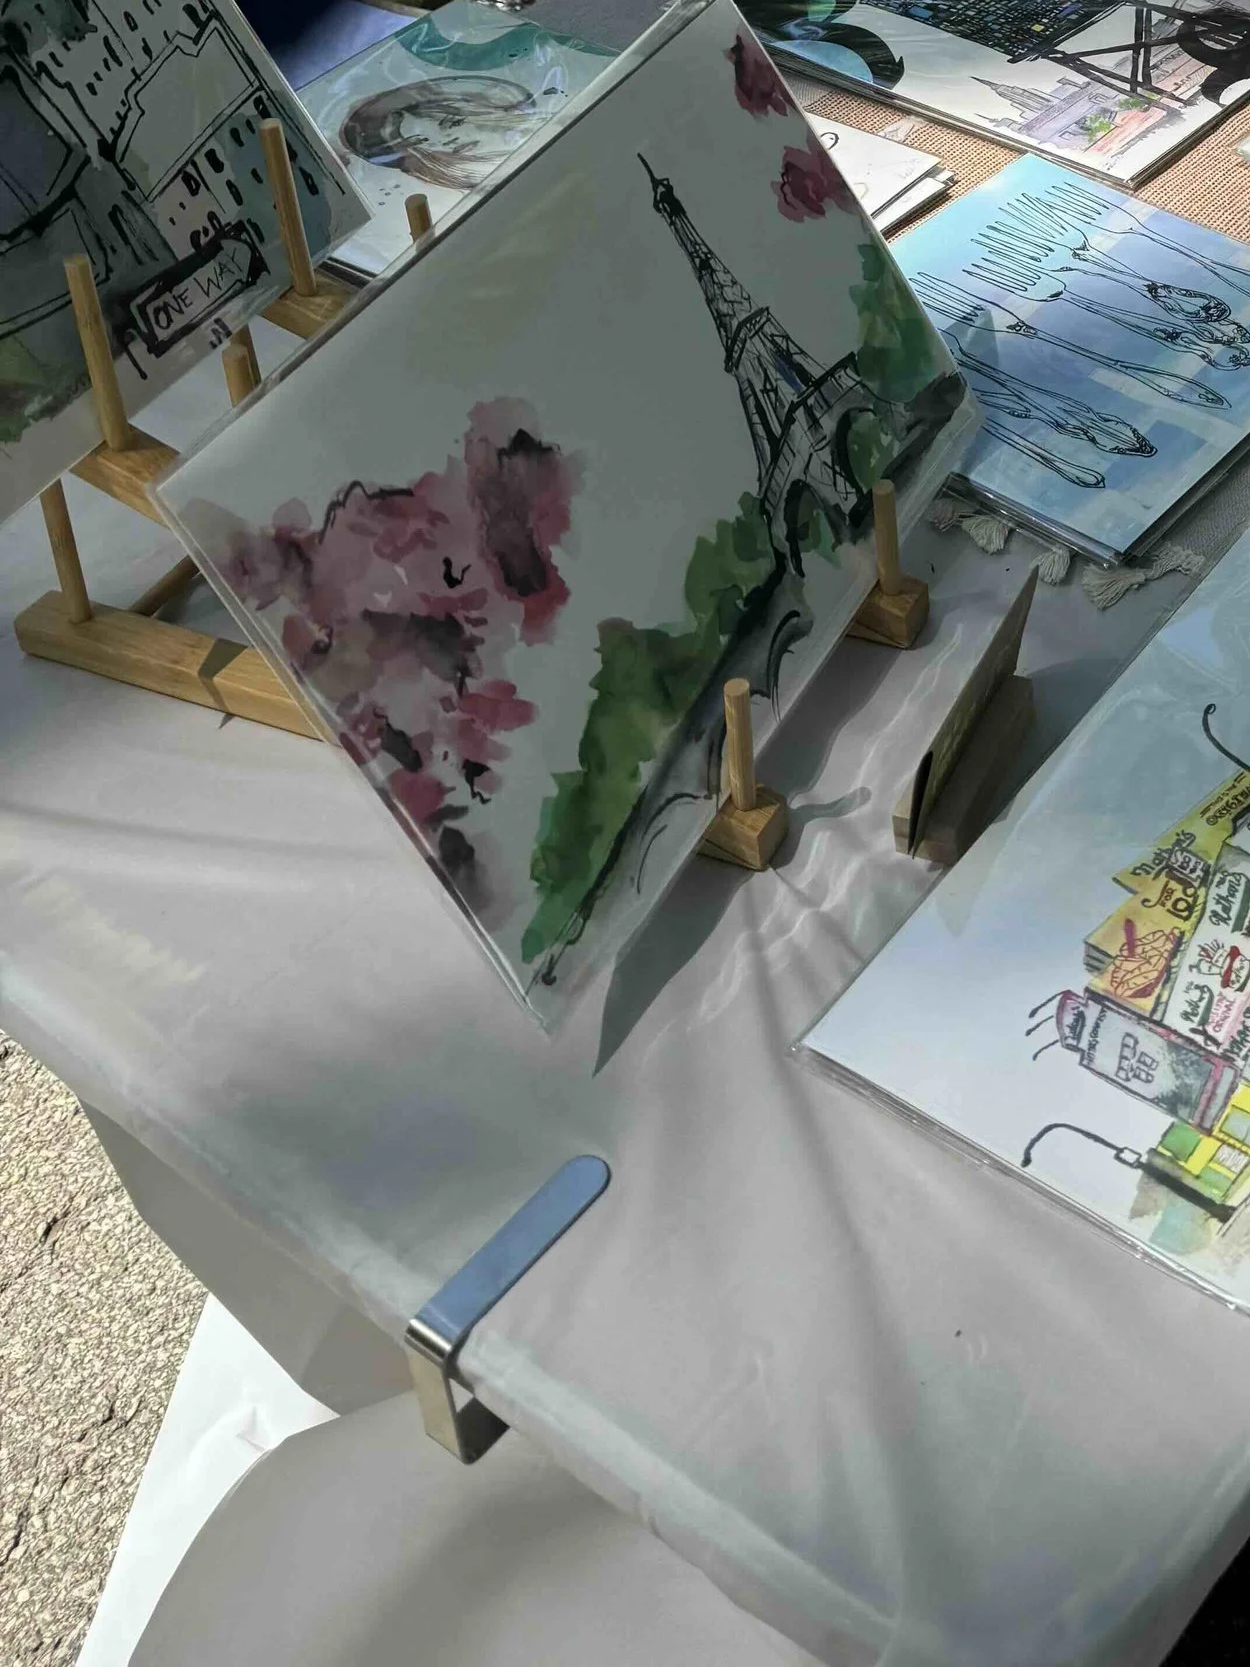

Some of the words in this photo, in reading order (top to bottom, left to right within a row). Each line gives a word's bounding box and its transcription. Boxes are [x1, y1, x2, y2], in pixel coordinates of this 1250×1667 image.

[153, 288, 193, 330] ONE
[194, 248, 243, 298] WAY
[1159, 886, 1175, 907] FOR
